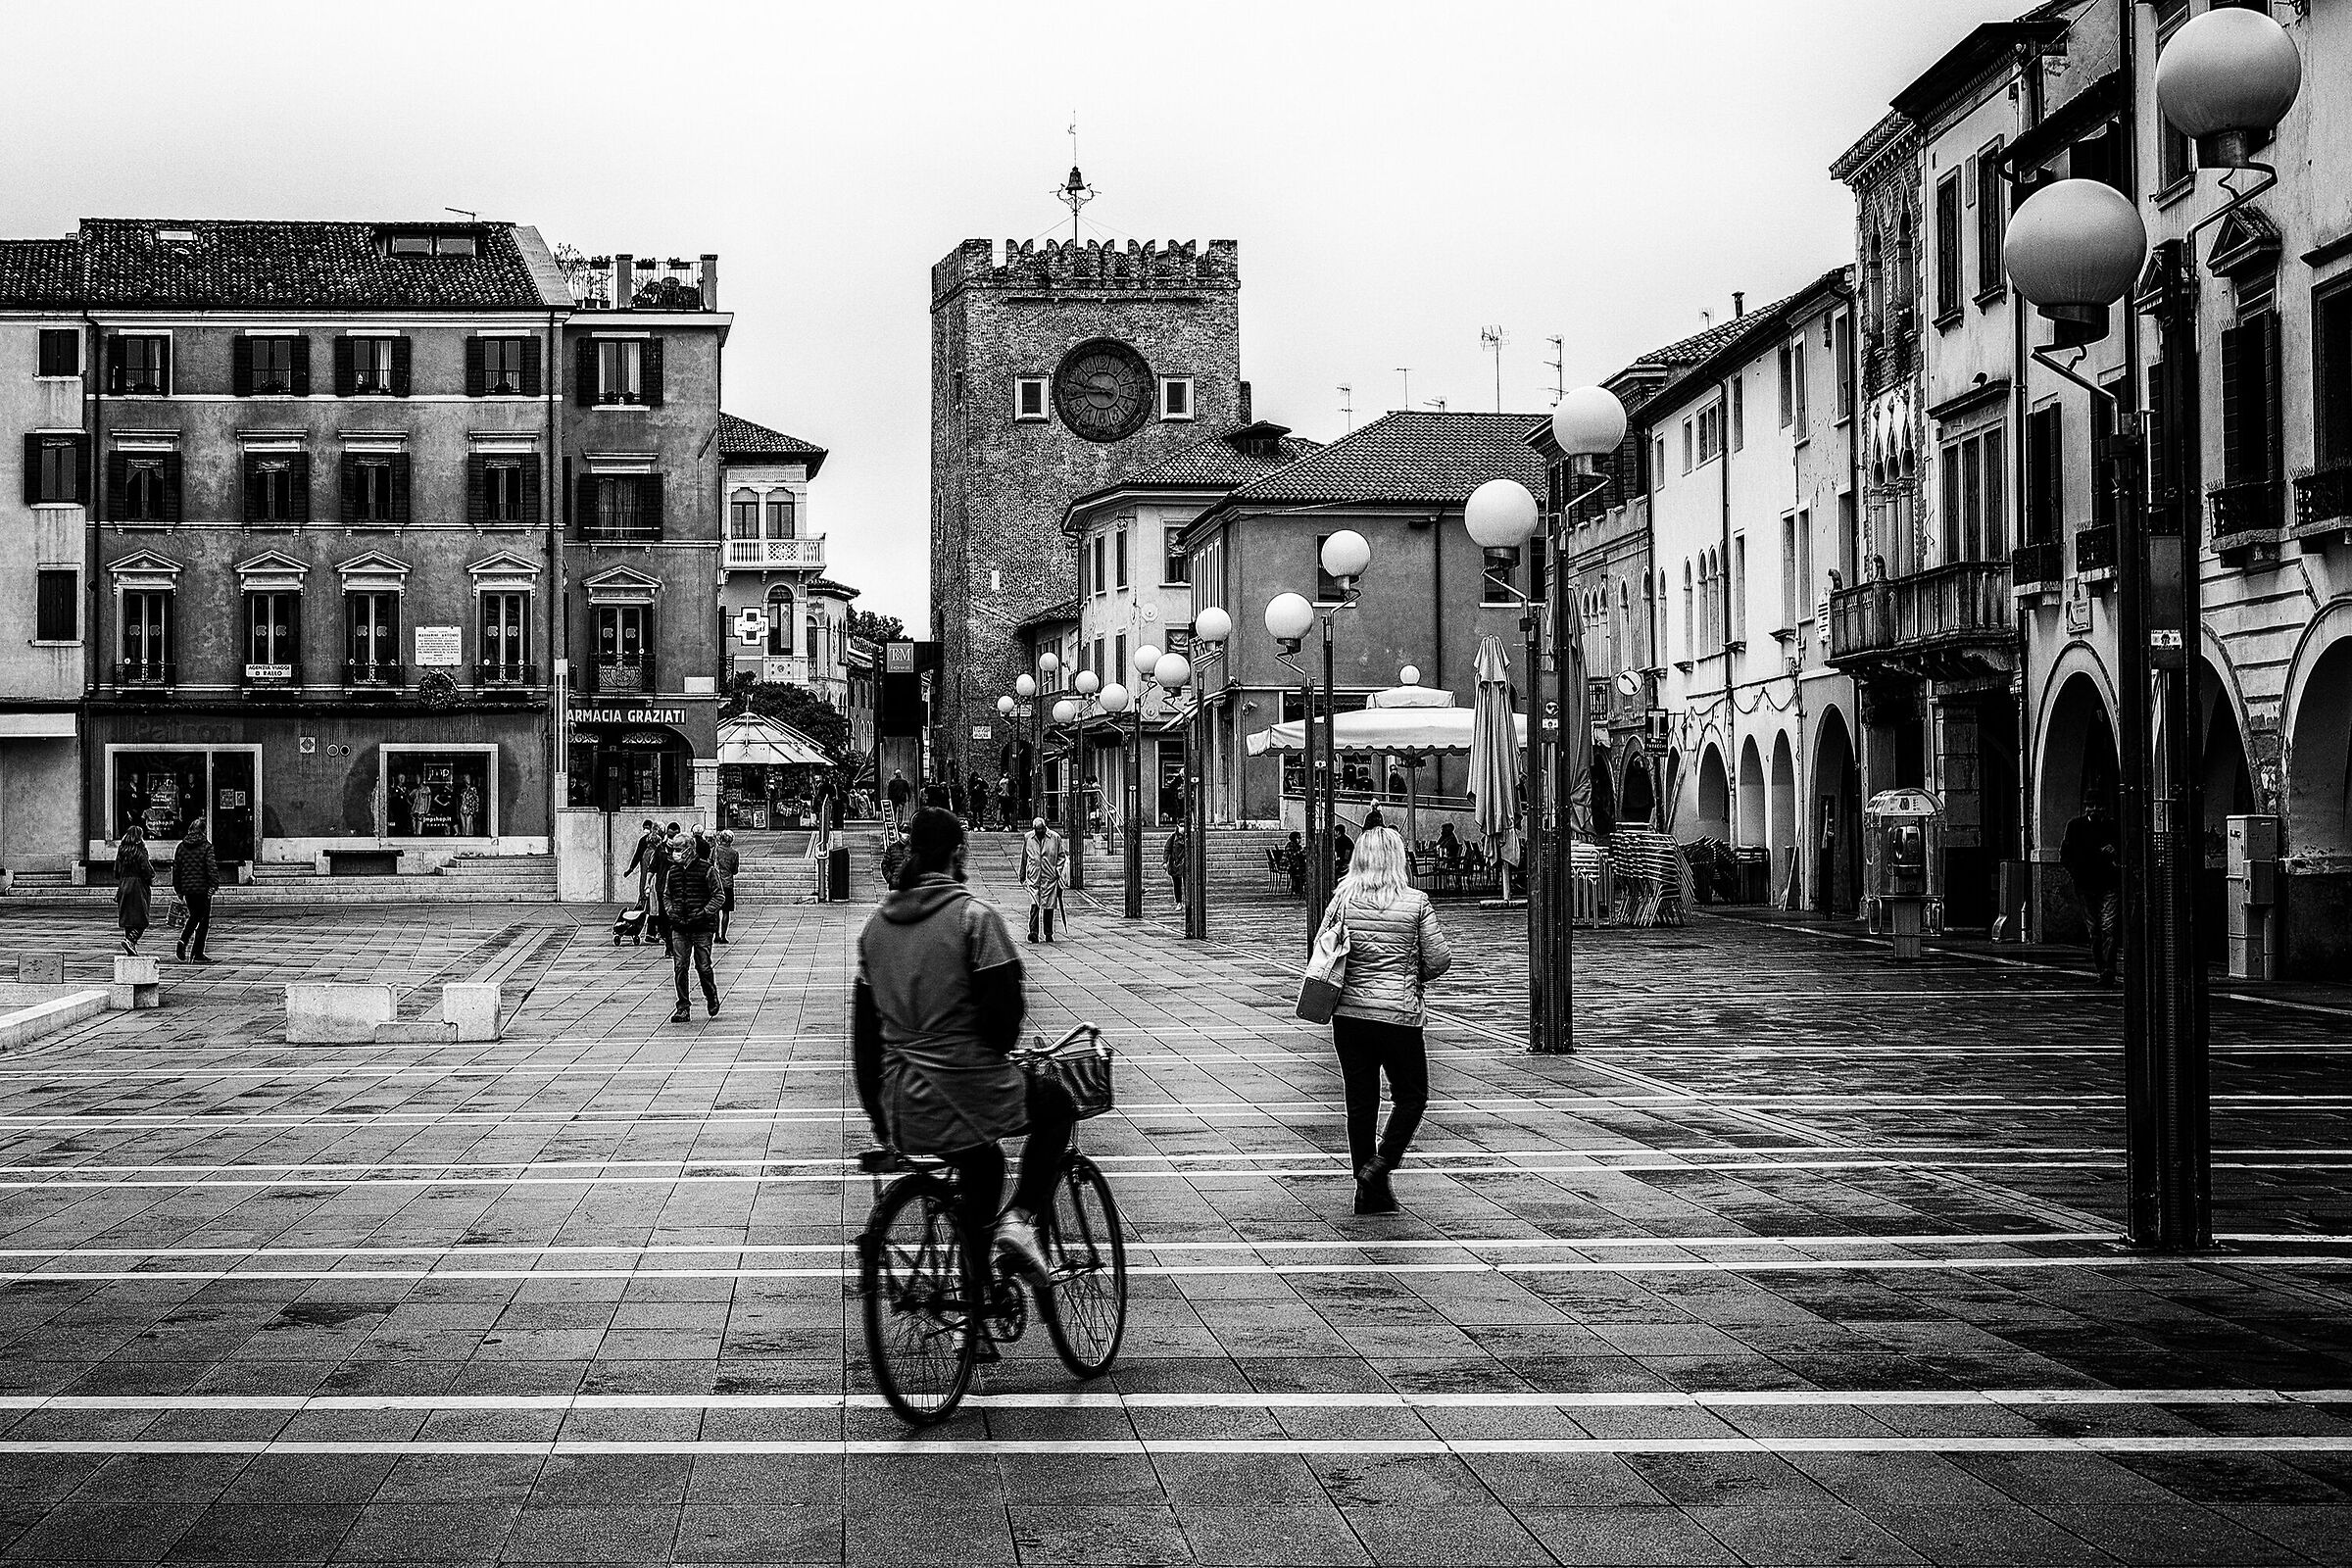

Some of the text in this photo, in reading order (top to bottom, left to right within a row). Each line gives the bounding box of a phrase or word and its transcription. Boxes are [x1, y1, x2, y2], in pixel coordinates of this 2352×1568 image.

[568, 710, 685, 722] ARMACIA GRAZIATI
[1648, 710, 1665, 738] T
